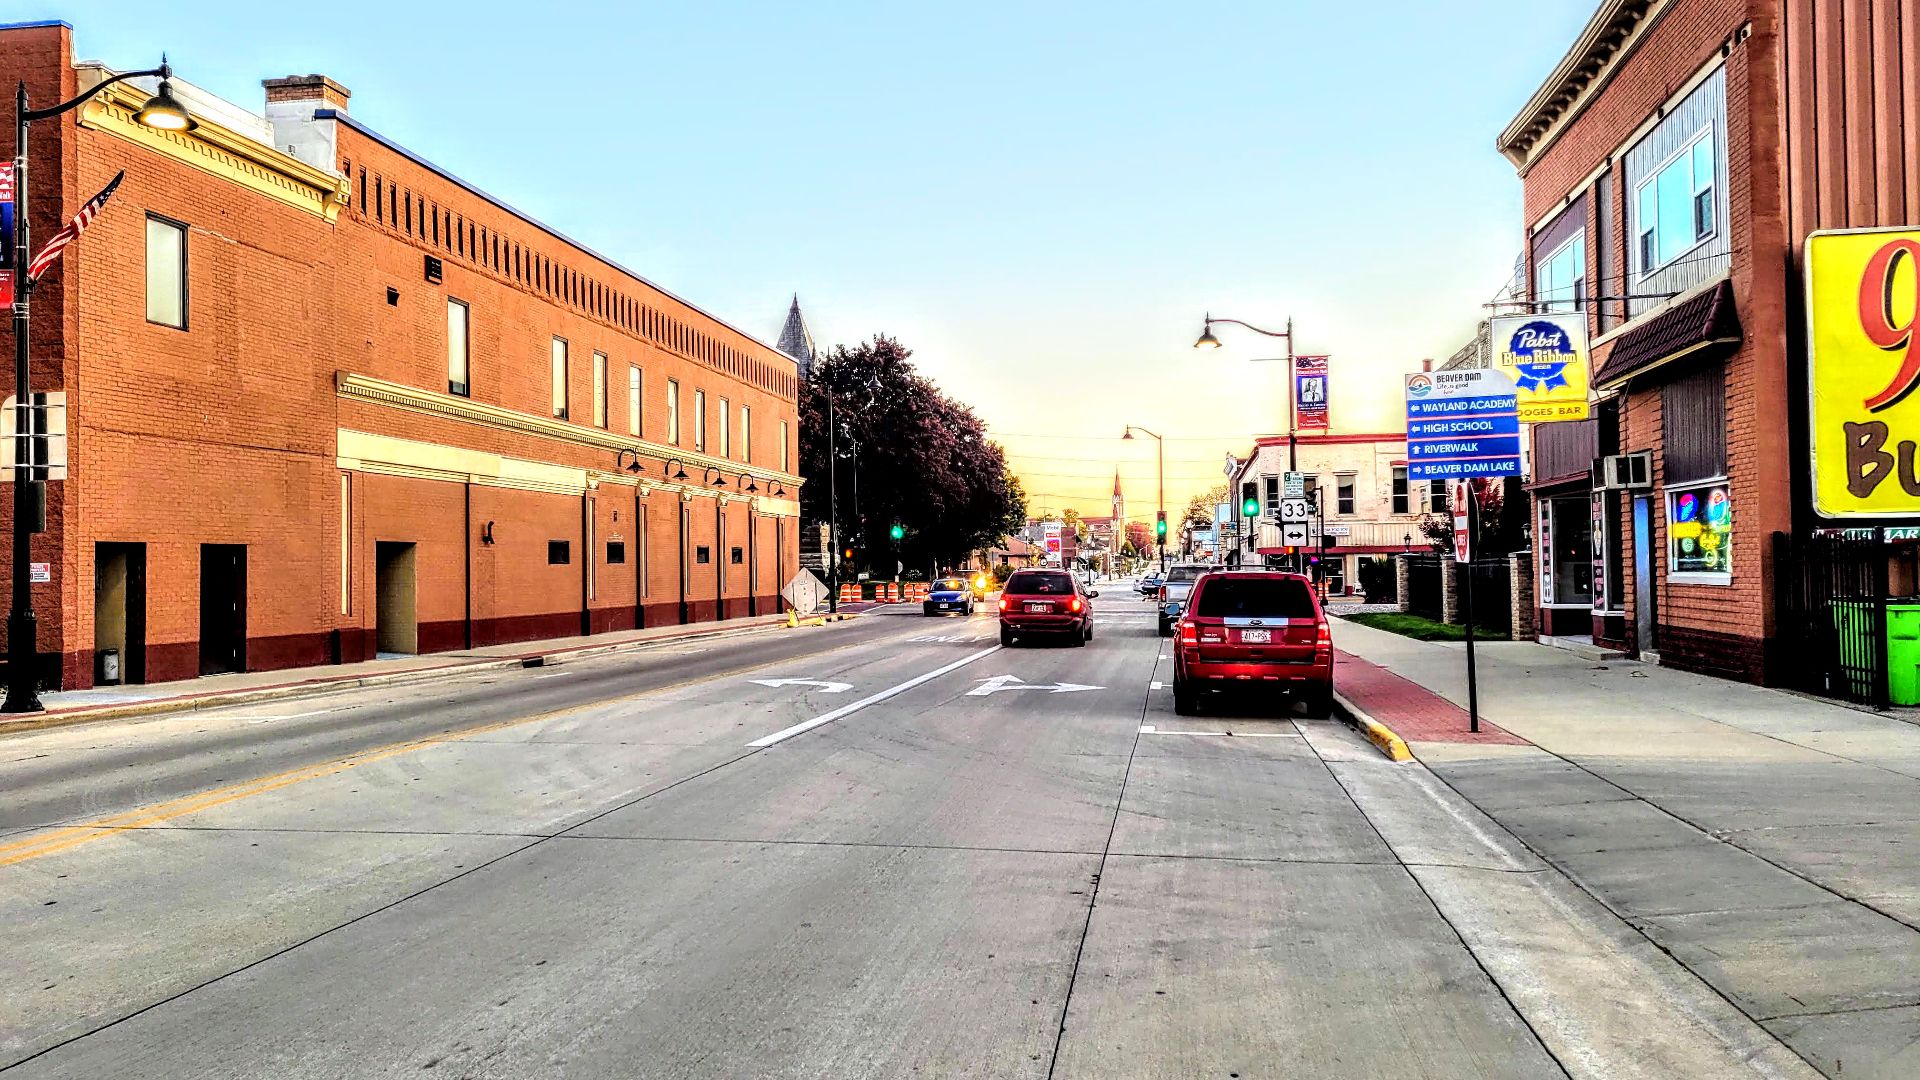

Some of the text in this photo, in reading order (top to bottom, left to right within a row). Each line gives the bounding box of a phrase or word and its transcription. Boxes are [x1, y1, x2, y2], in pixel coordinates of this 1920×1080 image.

[1518, 329, 1562, 348] Pabst
[1502, 349, 1577, 366] Blue Ribbon
[1437, 372, 1482, 383] BEAVER DAM
[1423, 399, 1517, 412] WAYLAND ACADEMY
[1423, 421, 1493, 433] HIGH SCHOOL
[1424, 443, 1478, 453] RIVERWALK
[1425, 462, 1515, 474] BEAVER DAM LAKE
[1285, 503, 1305, 517] 33
